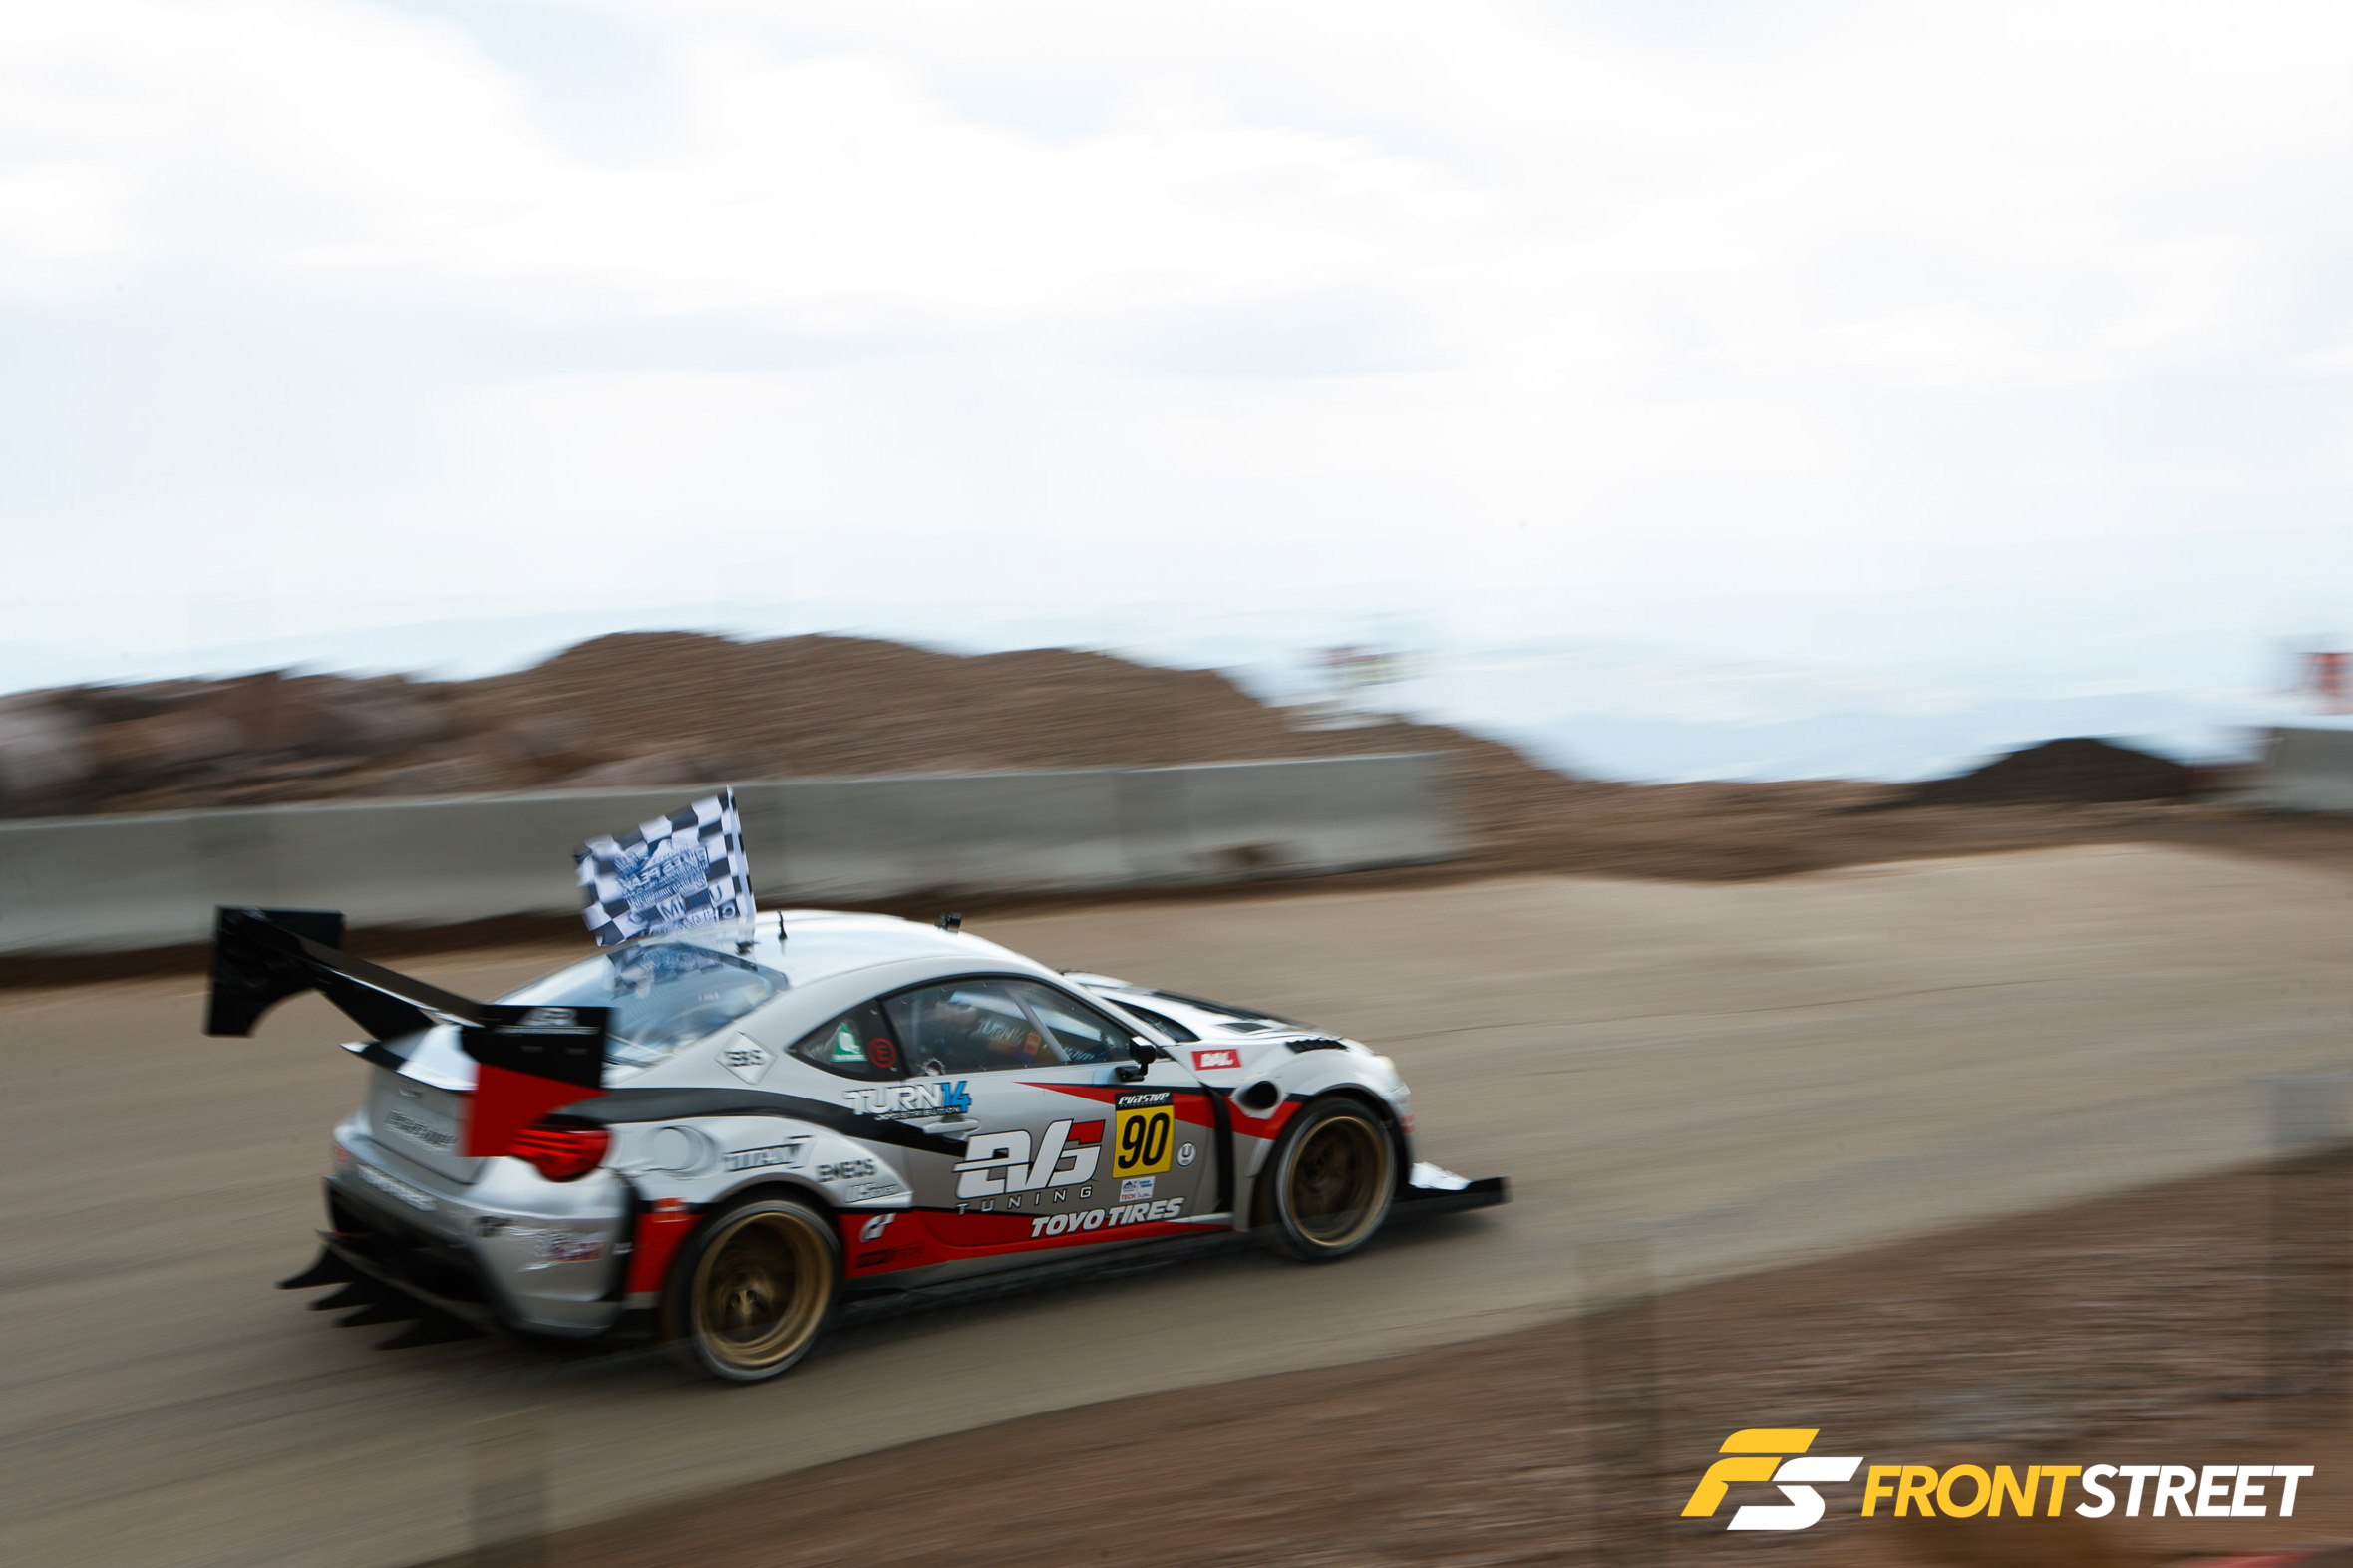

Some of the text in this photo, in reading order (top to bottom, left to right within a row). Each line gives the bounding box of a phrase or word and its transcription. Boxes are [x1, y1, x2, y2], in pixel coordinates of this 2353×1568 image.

[843, 1081, 972, 1115] TURN14
[1118, 1112, 1170, 1169] 90
[956, 1185, 1093, 1216] TUNING
[1031, 1196, 1186, 1238] TOYO TIRES
